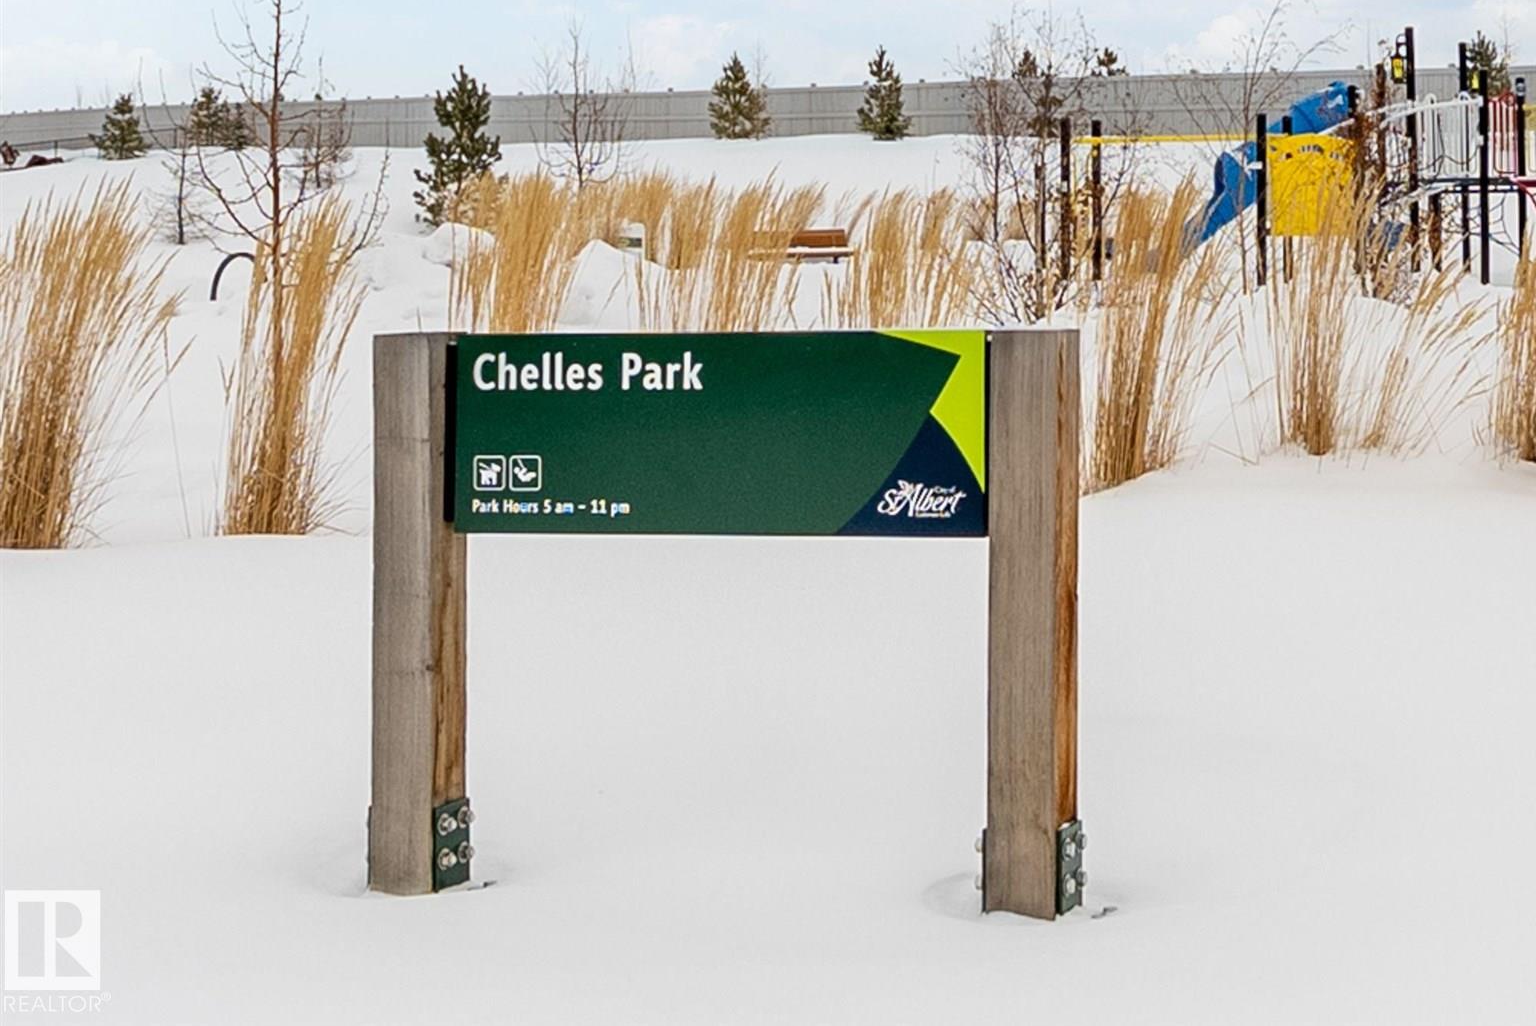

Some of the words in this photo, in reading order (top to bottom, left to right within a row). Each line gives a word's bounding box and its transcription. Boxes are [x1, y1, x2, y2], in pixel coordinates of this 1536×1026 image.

[473, 351, 604, 391] Chelles
[621, 350, 704, 391] Park
[471, 498, 499, 514] Park
[502, 498, 539, 514] Hours
[542, 498, 552, 514] 5
[554, 501, 574, 514] am
[589, 498, 607, 514] 11
[610, 501, 630, 518] pm
[899, 482, 967, 517] Albert
